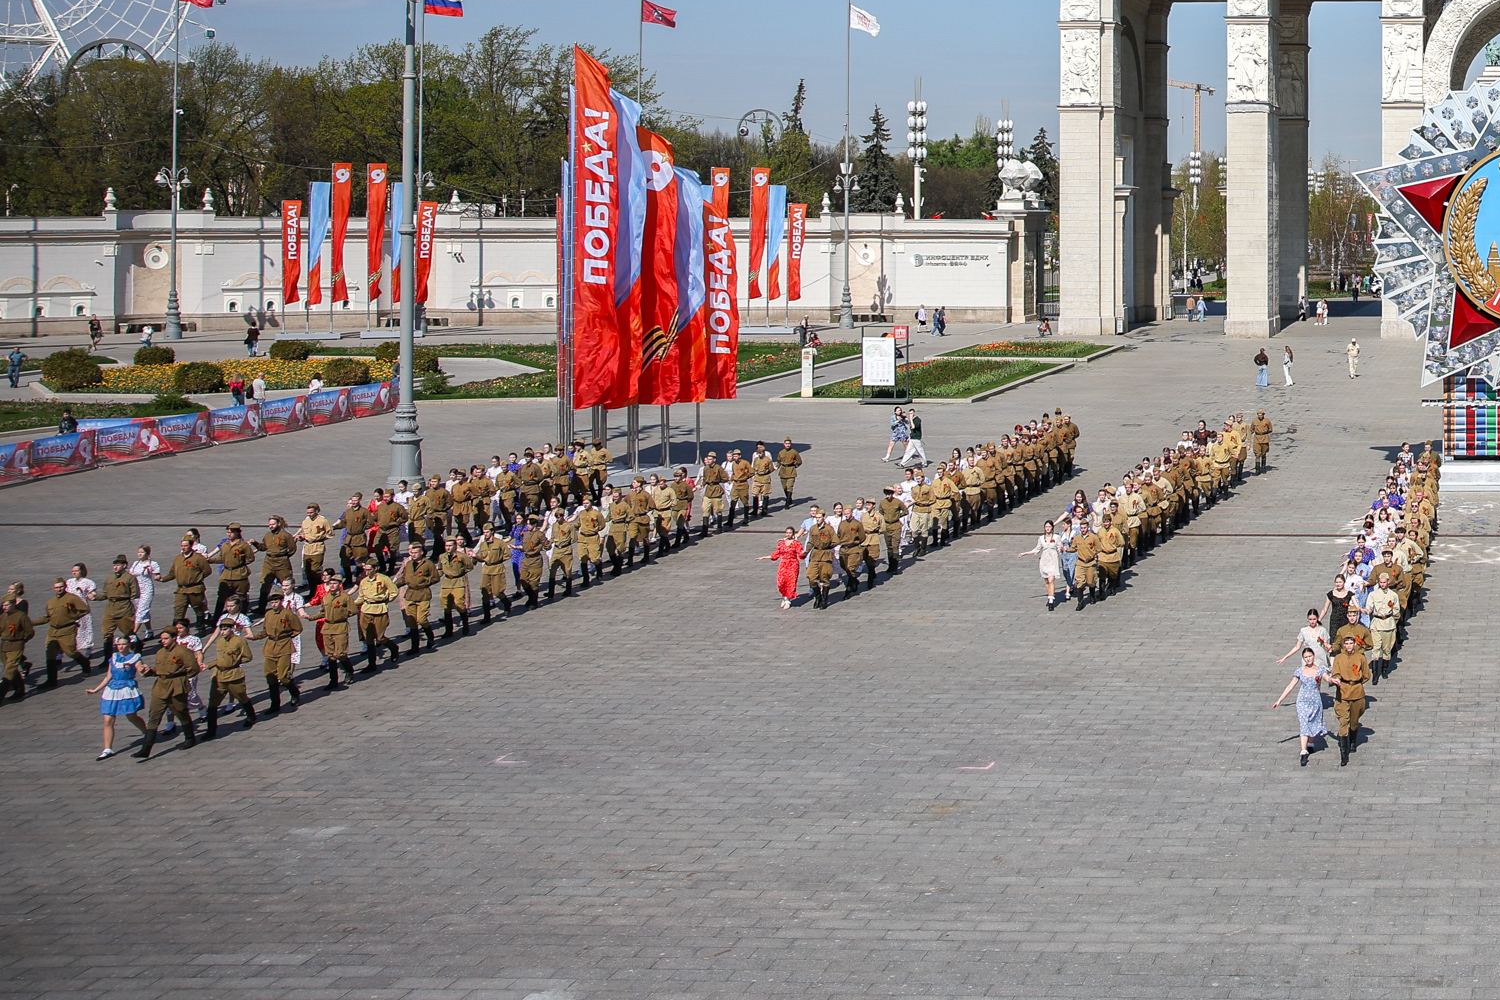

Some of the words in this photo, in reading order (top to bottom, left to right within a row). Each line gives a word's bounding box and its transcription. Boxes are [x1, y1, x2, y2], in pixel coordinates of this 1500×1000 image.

[335, 168, 350, 184] 9
[370, 168, 386, 184] 9
[714, 172, 728, 187] 9
[754, 172, 768, 187] 9
[583, 107, 614, 285] ПОБЕДА!
[287, 205, 298, 260] ПОБЕДА!
[419, 206, 434, 259] ПОБЕДА!
[791, 207, 803, 259] ПОБЕДА!
[708, 214, 733, 354] ПОБЕДА!
[309, 398, 334, 408] ПОБЕДА!
[351, 391, 376, 400] ПОБЕДА!
[213, 413, 244, 423] ПОБЕДА!
[265, 405, 291, 416] ПОБЕДА!
[161, 422, 192, 433] ПОБЕДА!
[100, 431, 135, 443] ПОБЕДА!
[37, 442, 74, 456] ПОБЕДА!
